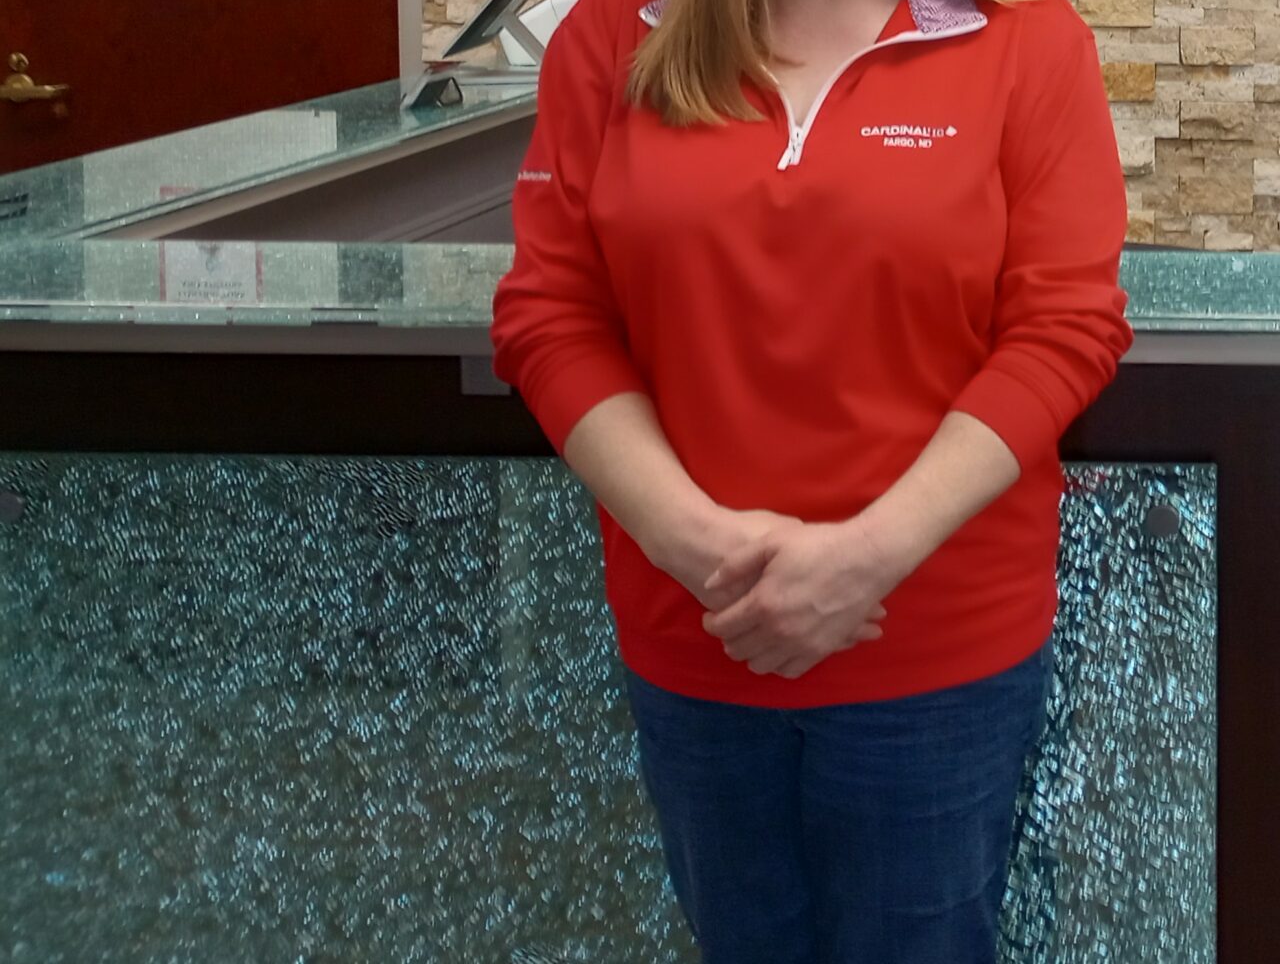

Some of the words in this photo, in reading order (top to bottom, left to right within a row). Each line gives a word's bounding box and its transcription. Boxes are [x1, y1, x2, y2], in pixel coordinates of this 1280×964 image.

[861, 125, 930, 137] CARDINAL
[883, 137, 917, 148] FARGO,
[919, 138, 932, 148] ND
